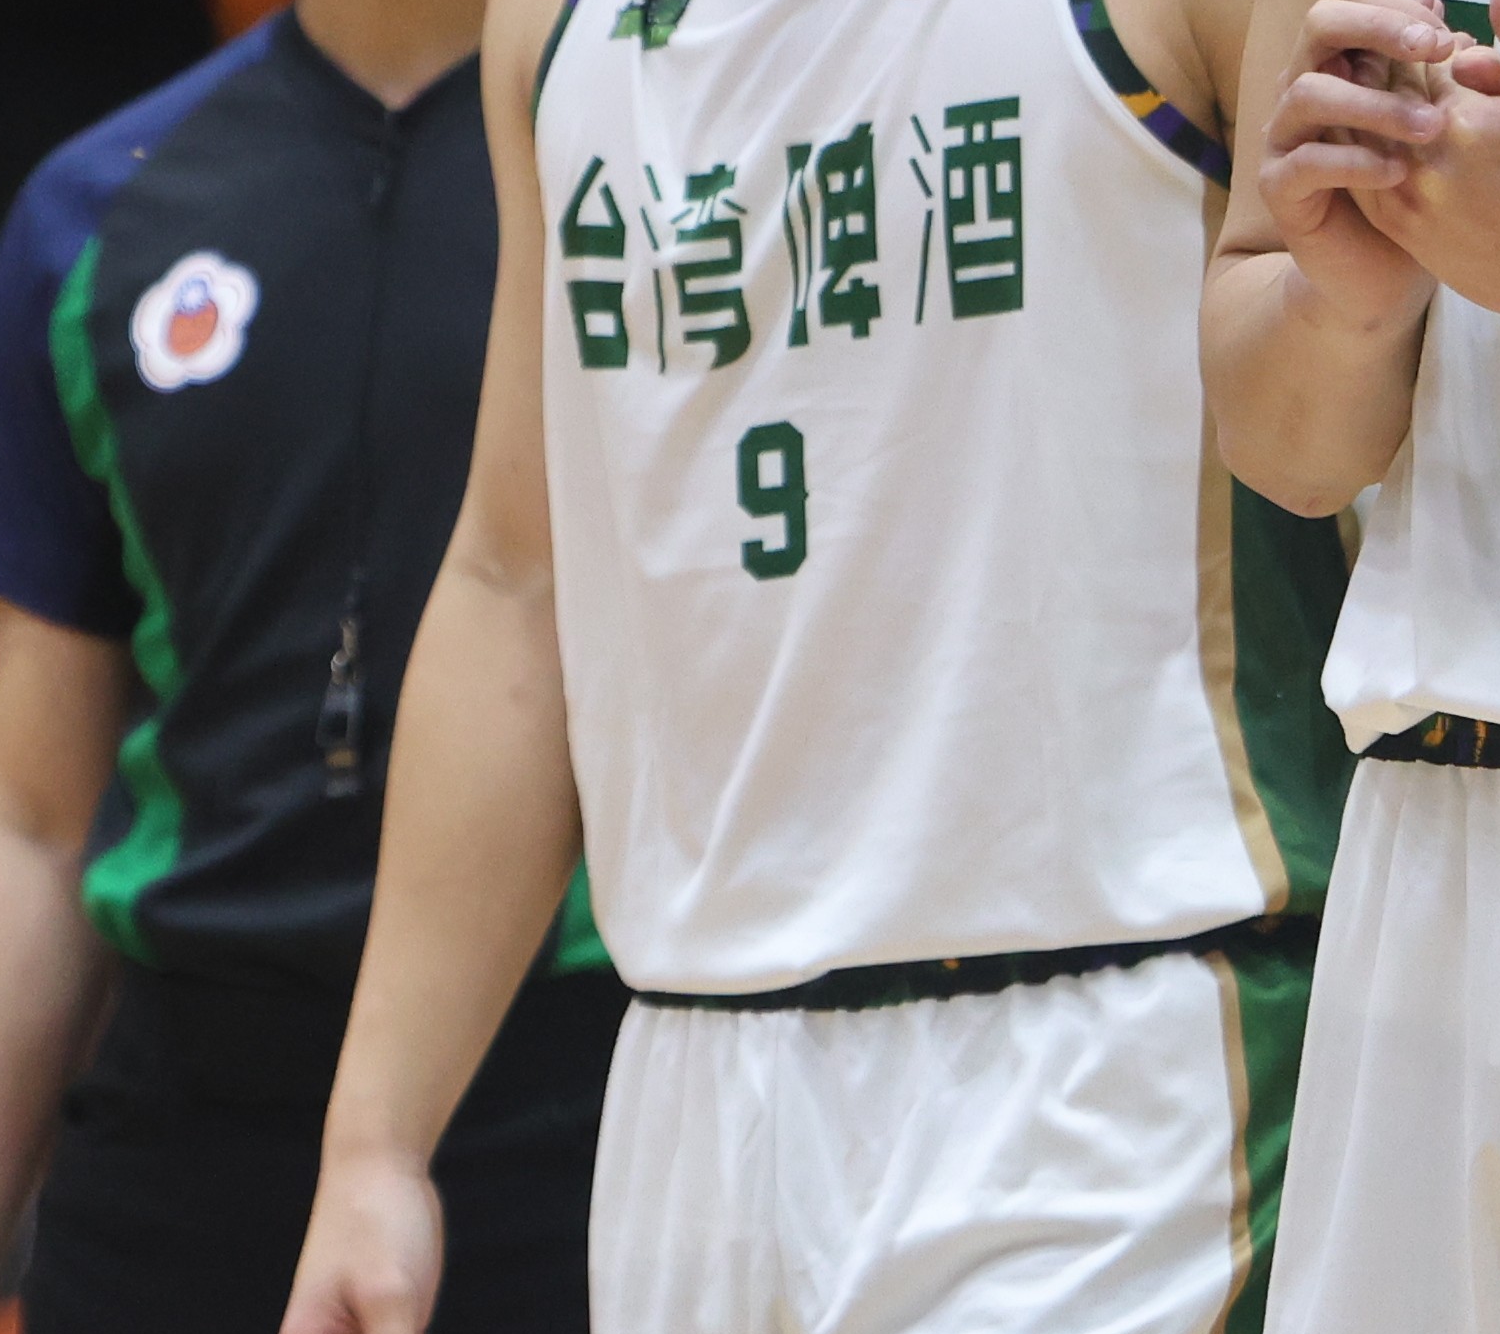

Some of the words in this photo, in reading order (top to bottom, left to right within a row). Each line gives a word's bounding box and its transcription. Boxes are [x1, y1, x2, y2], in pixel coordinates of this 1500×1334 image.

[558, 94, 1026, 376] 台灣啤酒
[736, 419, 809, 582] 9
